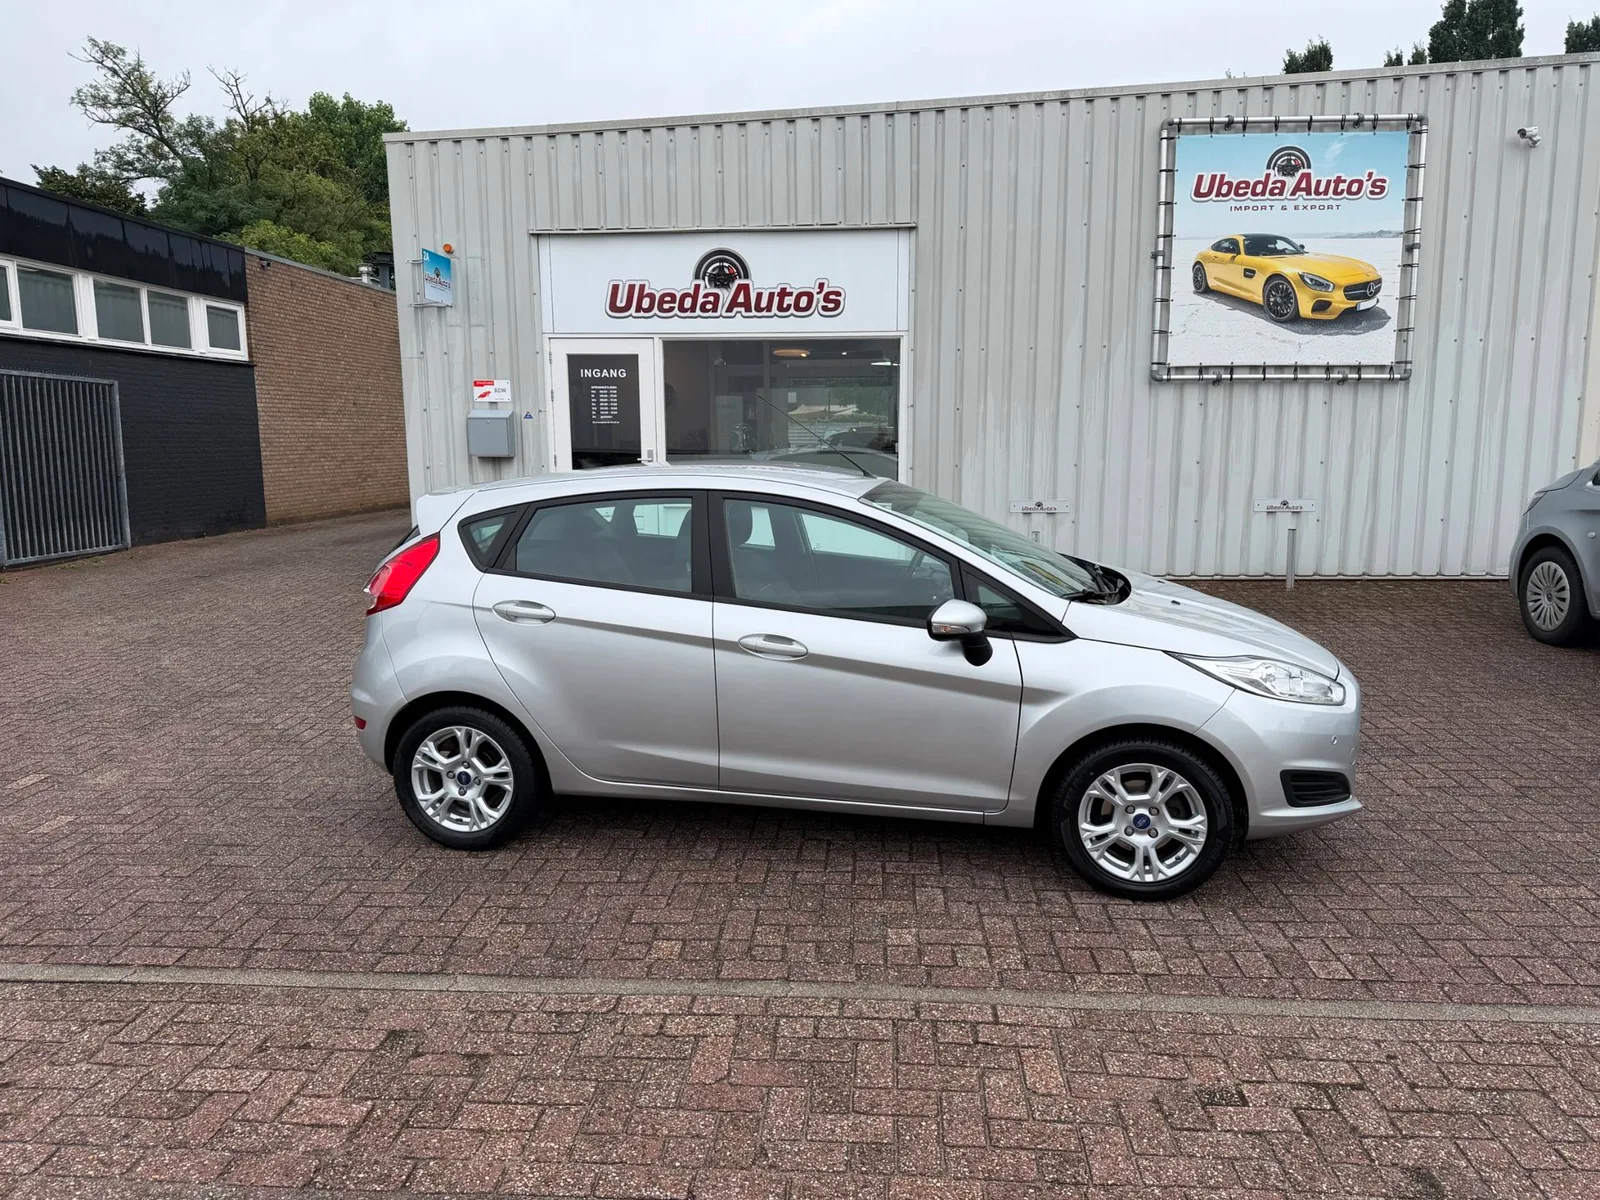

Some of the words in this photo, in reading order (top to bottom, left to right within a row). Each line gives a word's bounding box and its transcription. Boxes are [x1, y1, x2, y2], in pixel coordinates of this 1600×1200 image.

[1193, 172, 1287, 199] Ubeda
[1289, 171, 1387, 198] Auto's
[1229, 204, 1275, 212] IMPORT
[423, 250, 430, 261] 2A
[607, 282, 721, 314] Ubeda
[724, 281, 843, 314] Auto's
[580, 368, 627, 378] INGANG
